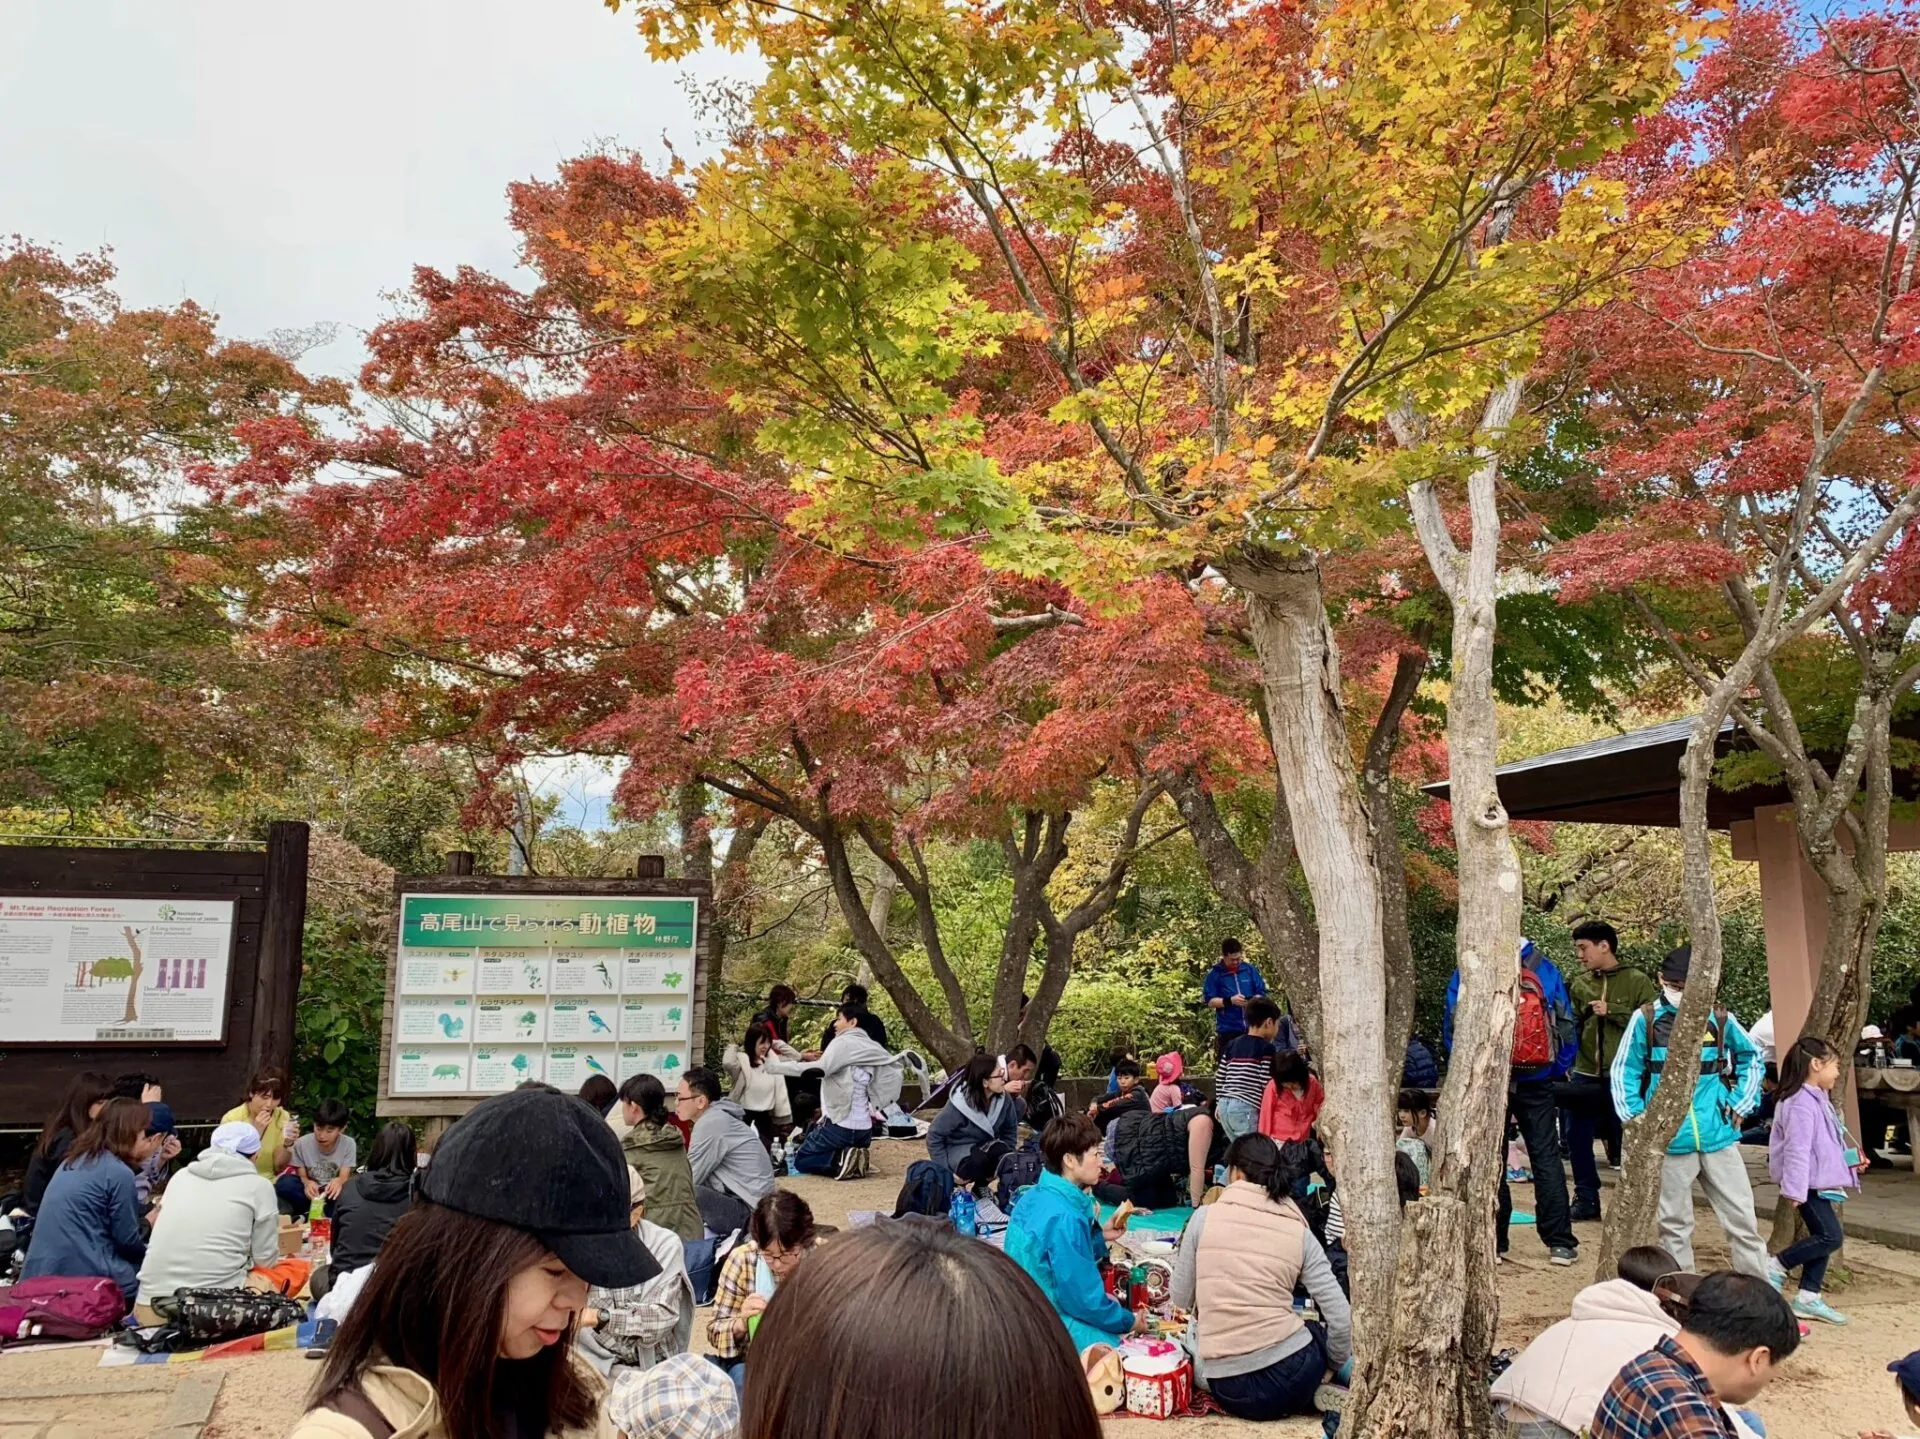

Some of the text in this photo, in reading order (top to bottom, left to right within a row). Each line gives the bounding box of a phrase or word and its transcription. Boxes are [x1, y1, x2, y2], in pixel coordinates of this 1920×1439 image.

[420, 912, 657, 935] 高尾山で見られる動植物
[654, 935, 679, 943] 林野庁
